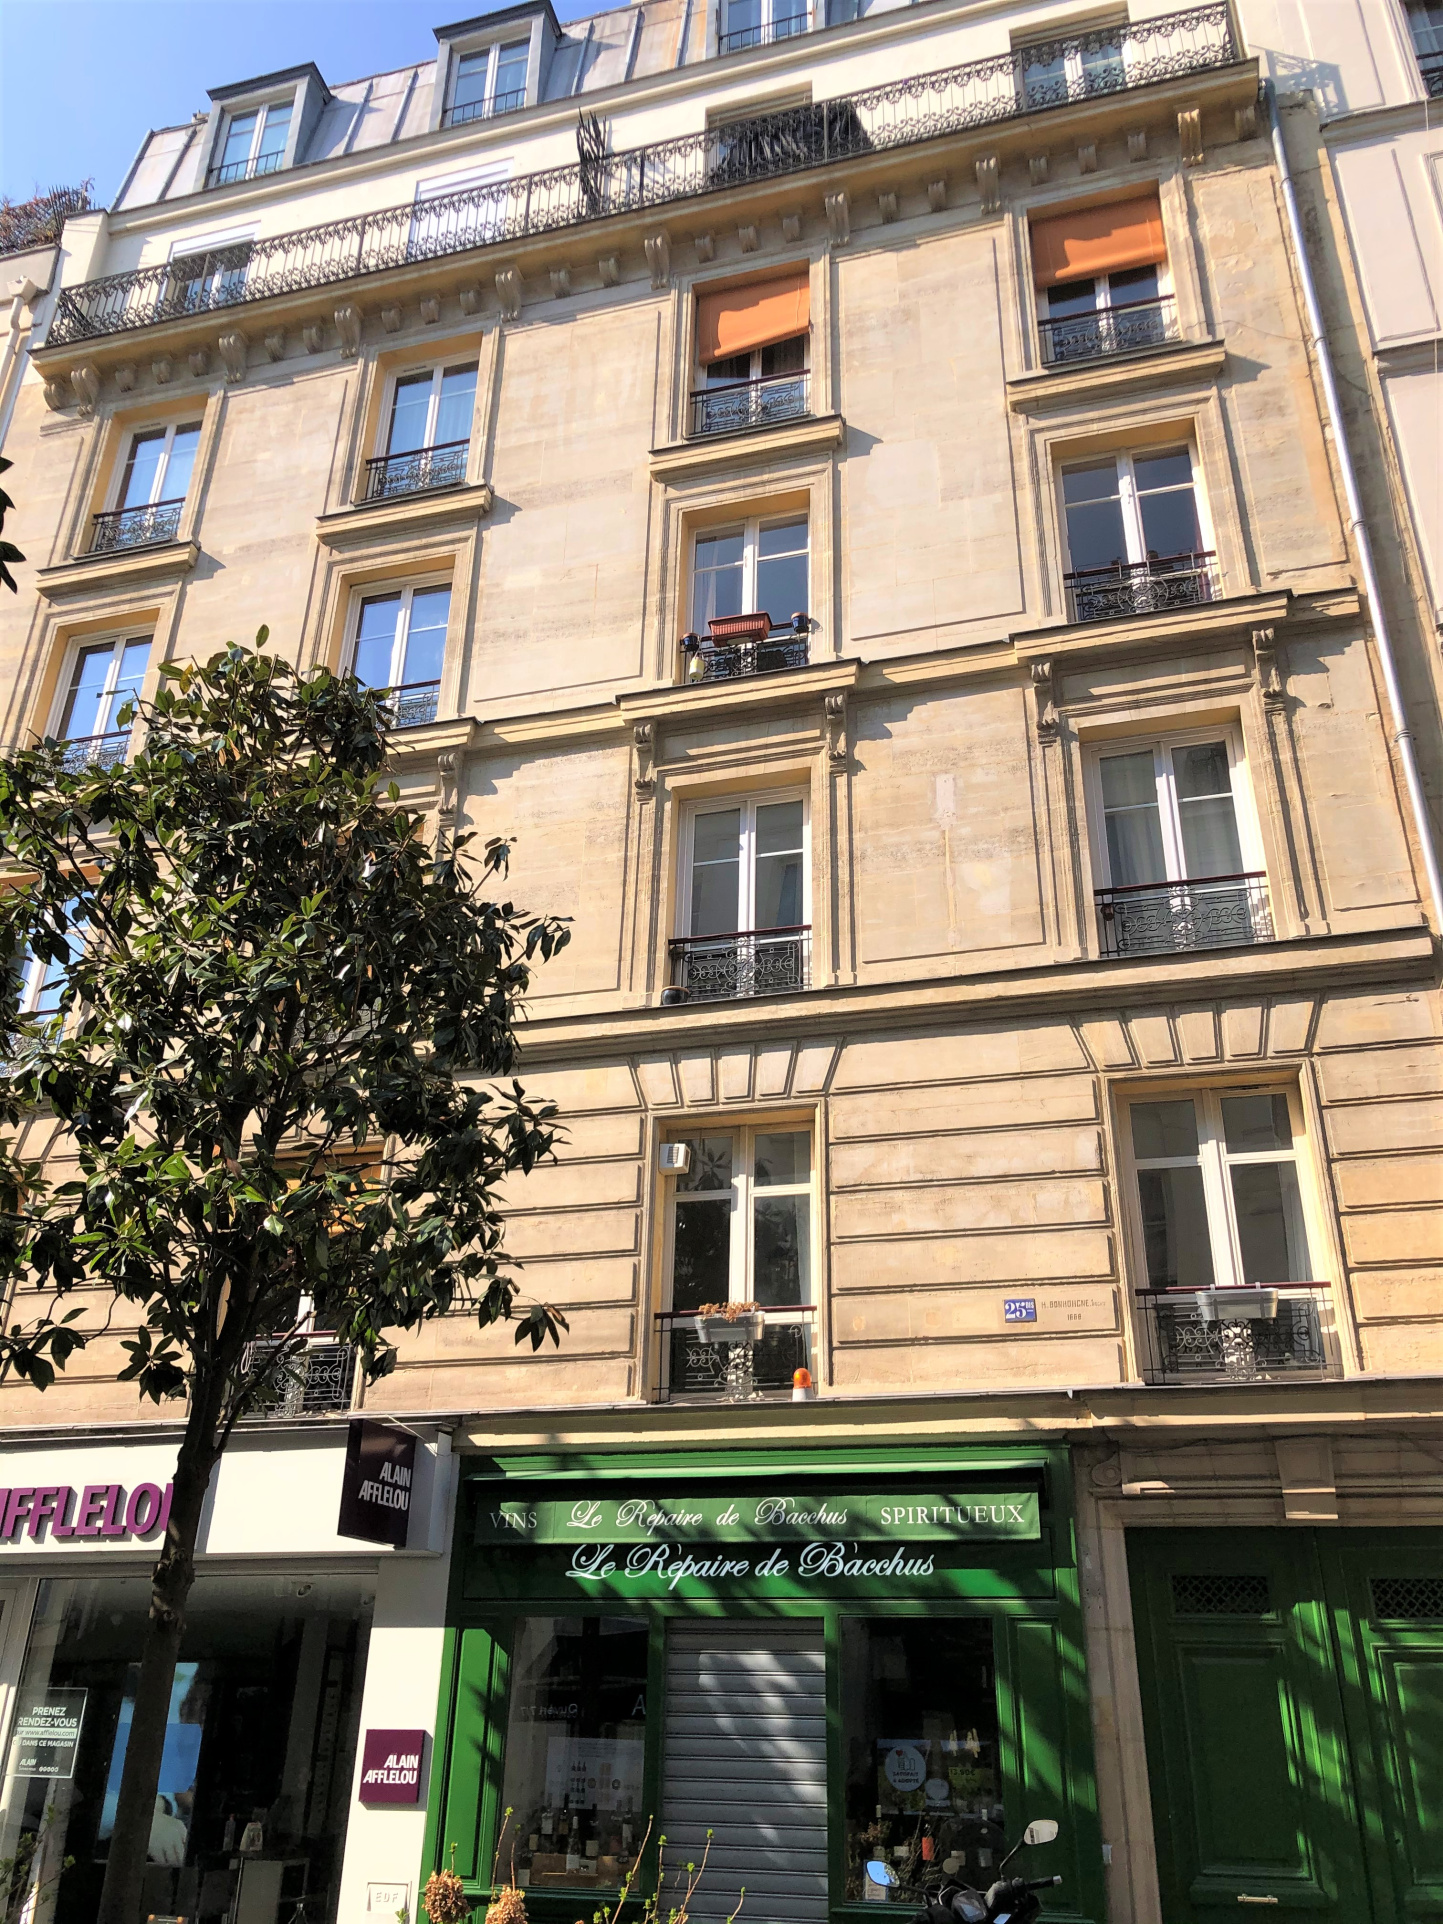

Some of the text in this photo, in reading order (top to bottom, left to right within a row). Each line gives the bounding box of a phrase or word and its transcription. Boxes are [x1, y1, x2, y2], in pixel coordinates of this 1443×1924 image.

[379, 1461, 411, 1488] ALAIN
[358, 1480, 410, 1511] AFFLELOU
[489, 1511, 537, 1529] VINS
[566, 1496, 848, 1536] Le Repaire de Bacchus
[880, 1504, 1025, 1525] SPIRITUEUX
[565, 1542, 935, 1590] Le Repaire de Bacchus
[32, 1706, 67, 1716] PRENEZ
[17, 1717, 78, 1727] RENDEZ-VOUS
[47, 1740, 74, 1748] MAGASIN
[384, 1754, 419, 1769] ALAIN
[362, 1769, 417, 1784] AFFLELOU
[375, 1892, 399, 1903] EDF
